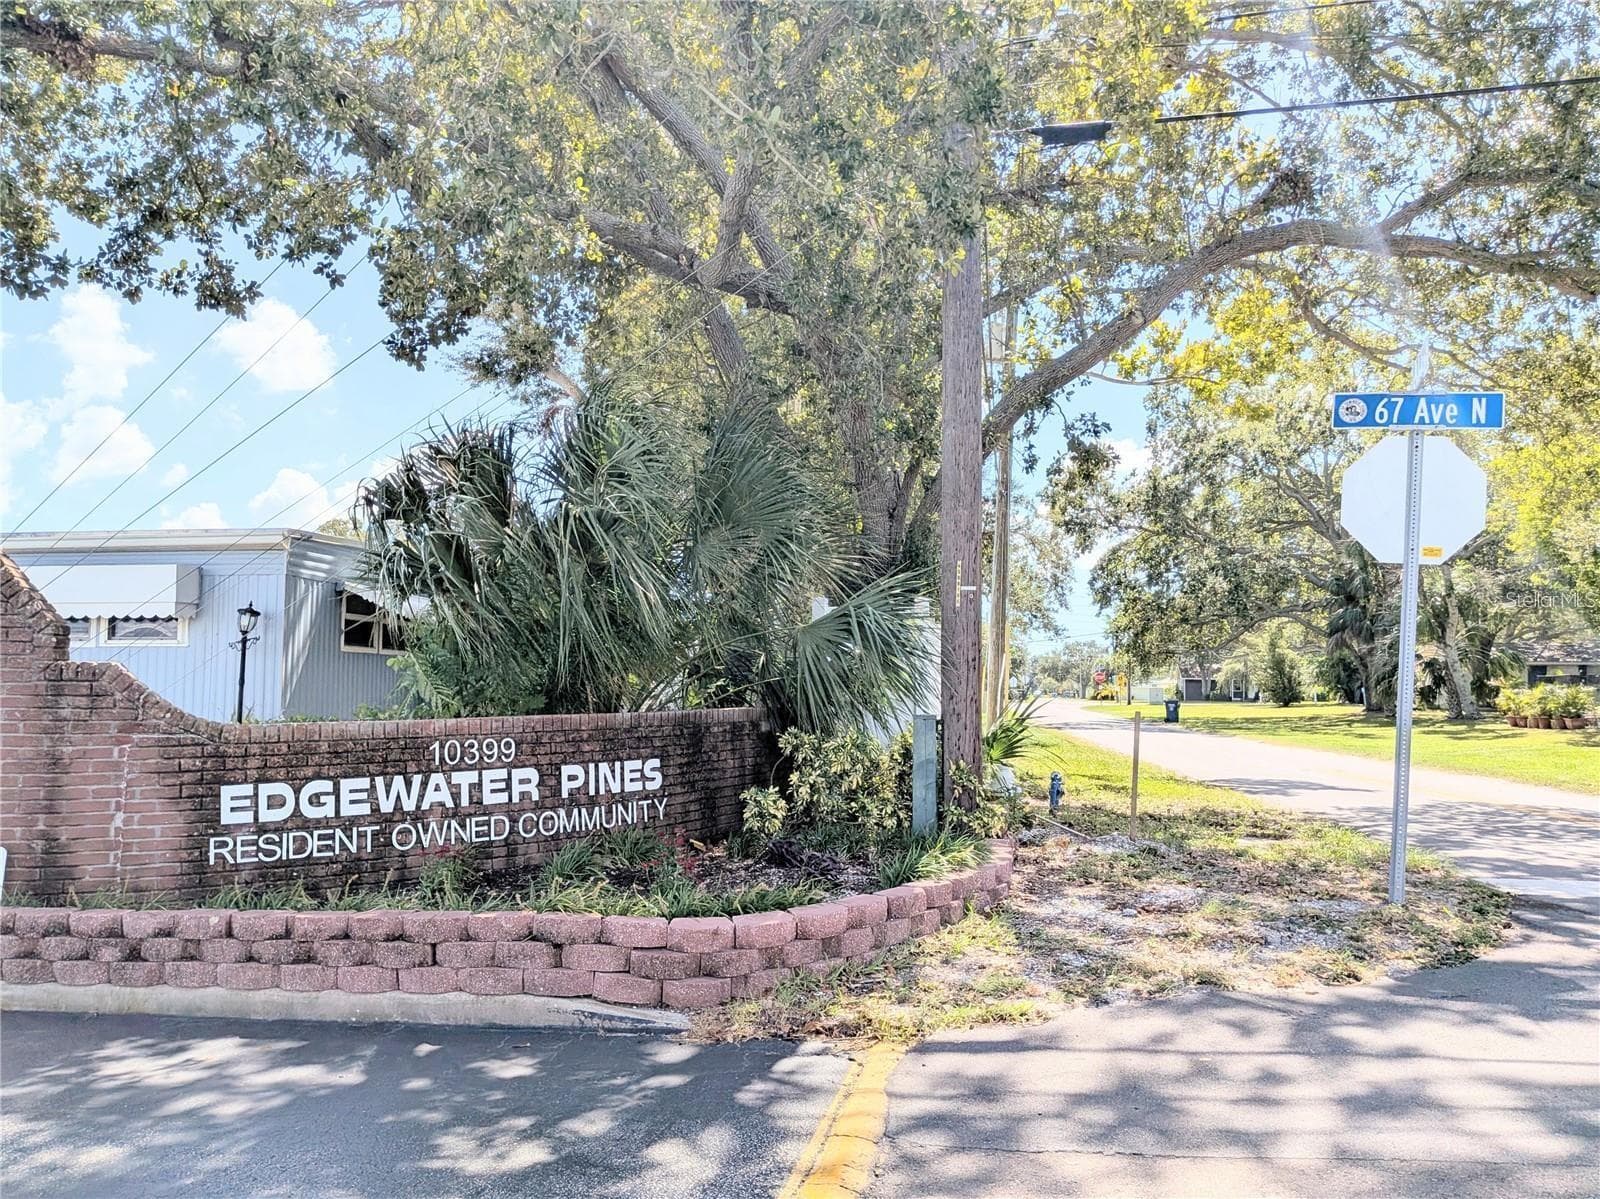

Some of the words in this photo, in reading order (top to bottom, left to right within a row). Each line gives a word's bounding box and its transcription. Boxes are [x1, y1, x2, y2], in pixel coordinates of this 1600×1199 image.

[1374, 397, 1404, 424] 67
[1413, 397, 1459, 424] Ave
[1471, 397, 1487, 424] N
[429, 737, 516, 766] 10399
[220, 767, 540, 825] EDGEWATER
[560, 758, 663, 799] PINES
[208, 825, 381, 866] RESIDENT
[391, 815, 510, 851] OWNED
[518, 797, 668, 839] COMMUNITY
